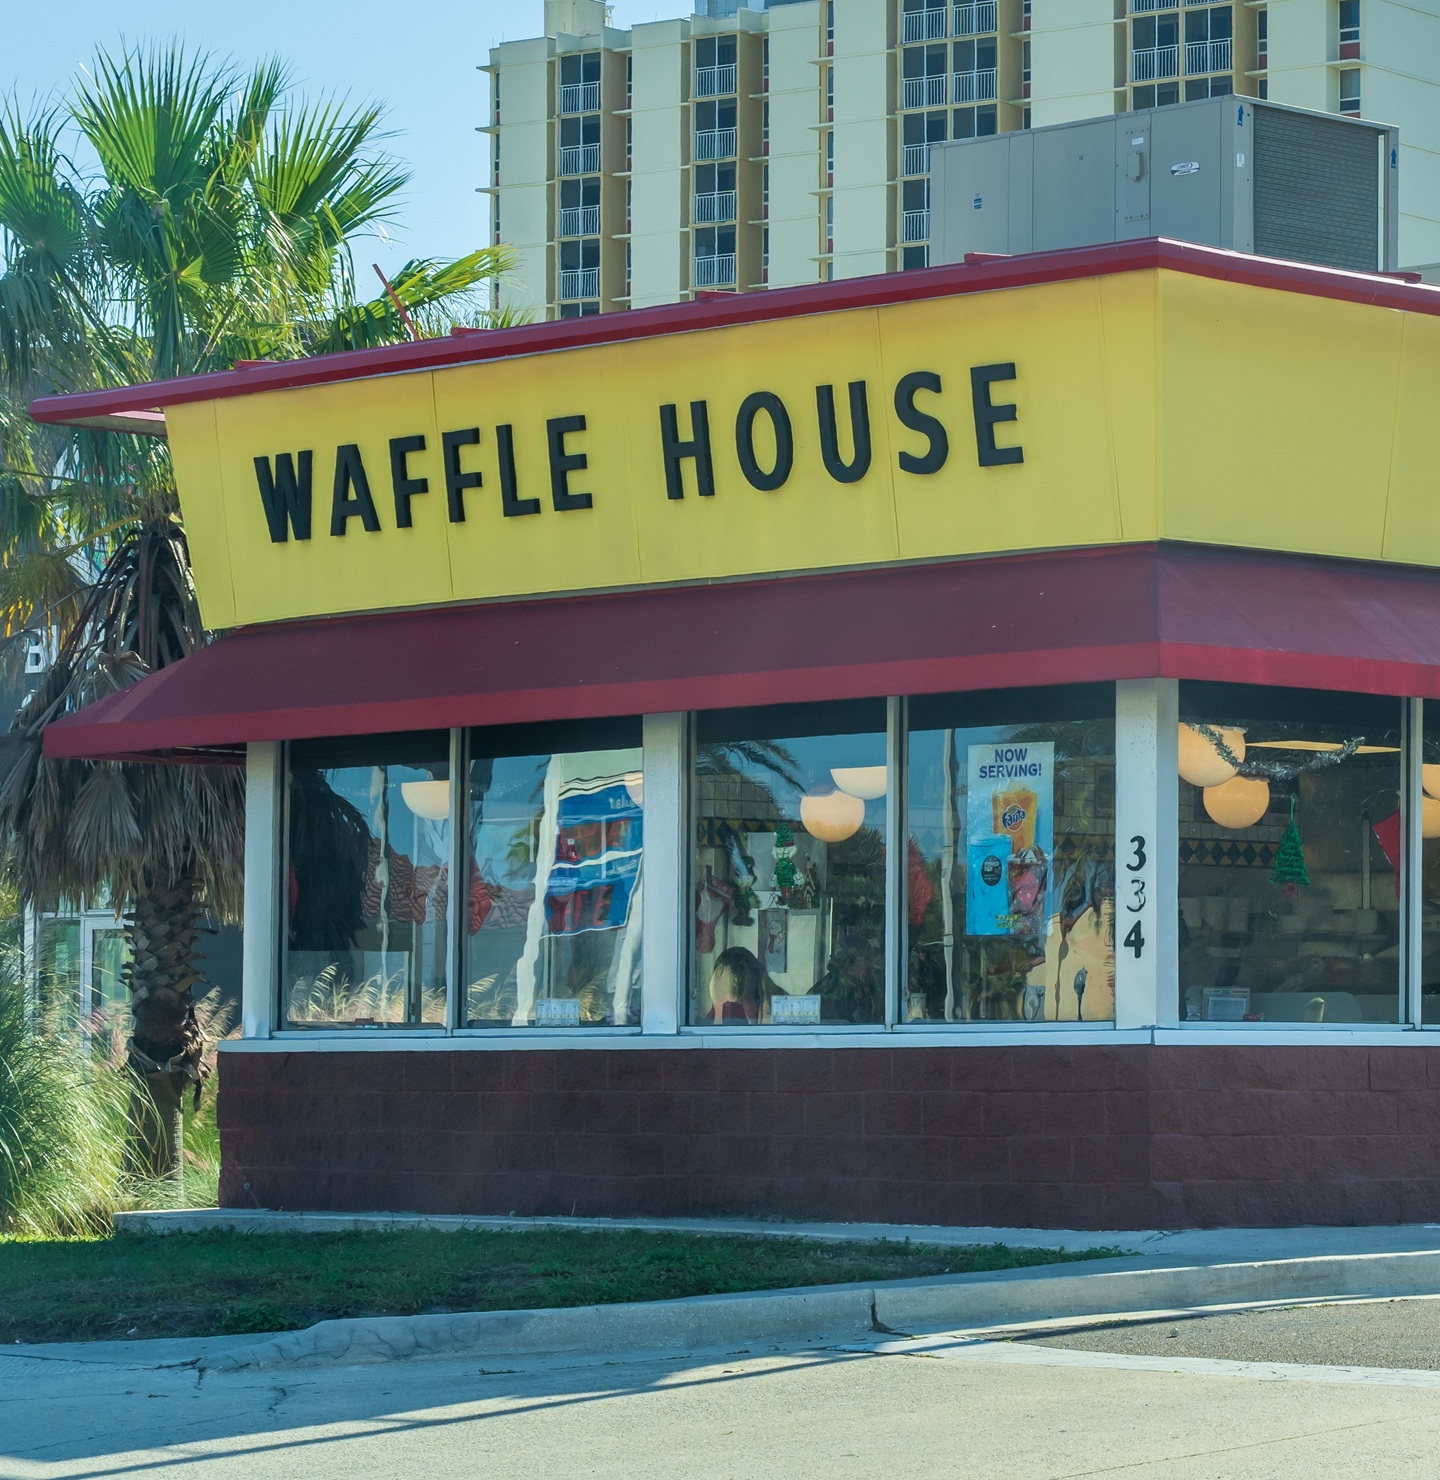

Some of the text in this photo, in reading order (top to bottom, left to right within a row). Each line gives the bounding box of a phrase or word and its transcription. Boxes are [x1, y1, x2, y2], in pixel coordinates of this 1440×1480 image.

[254, 362, 1024, 544] WAFFLE HOUSE
[994, 748, 1028, 763] NOW
[979, 763, 1042, 779] SERVING!
[1001, 808, 1026, 829] Fanta
